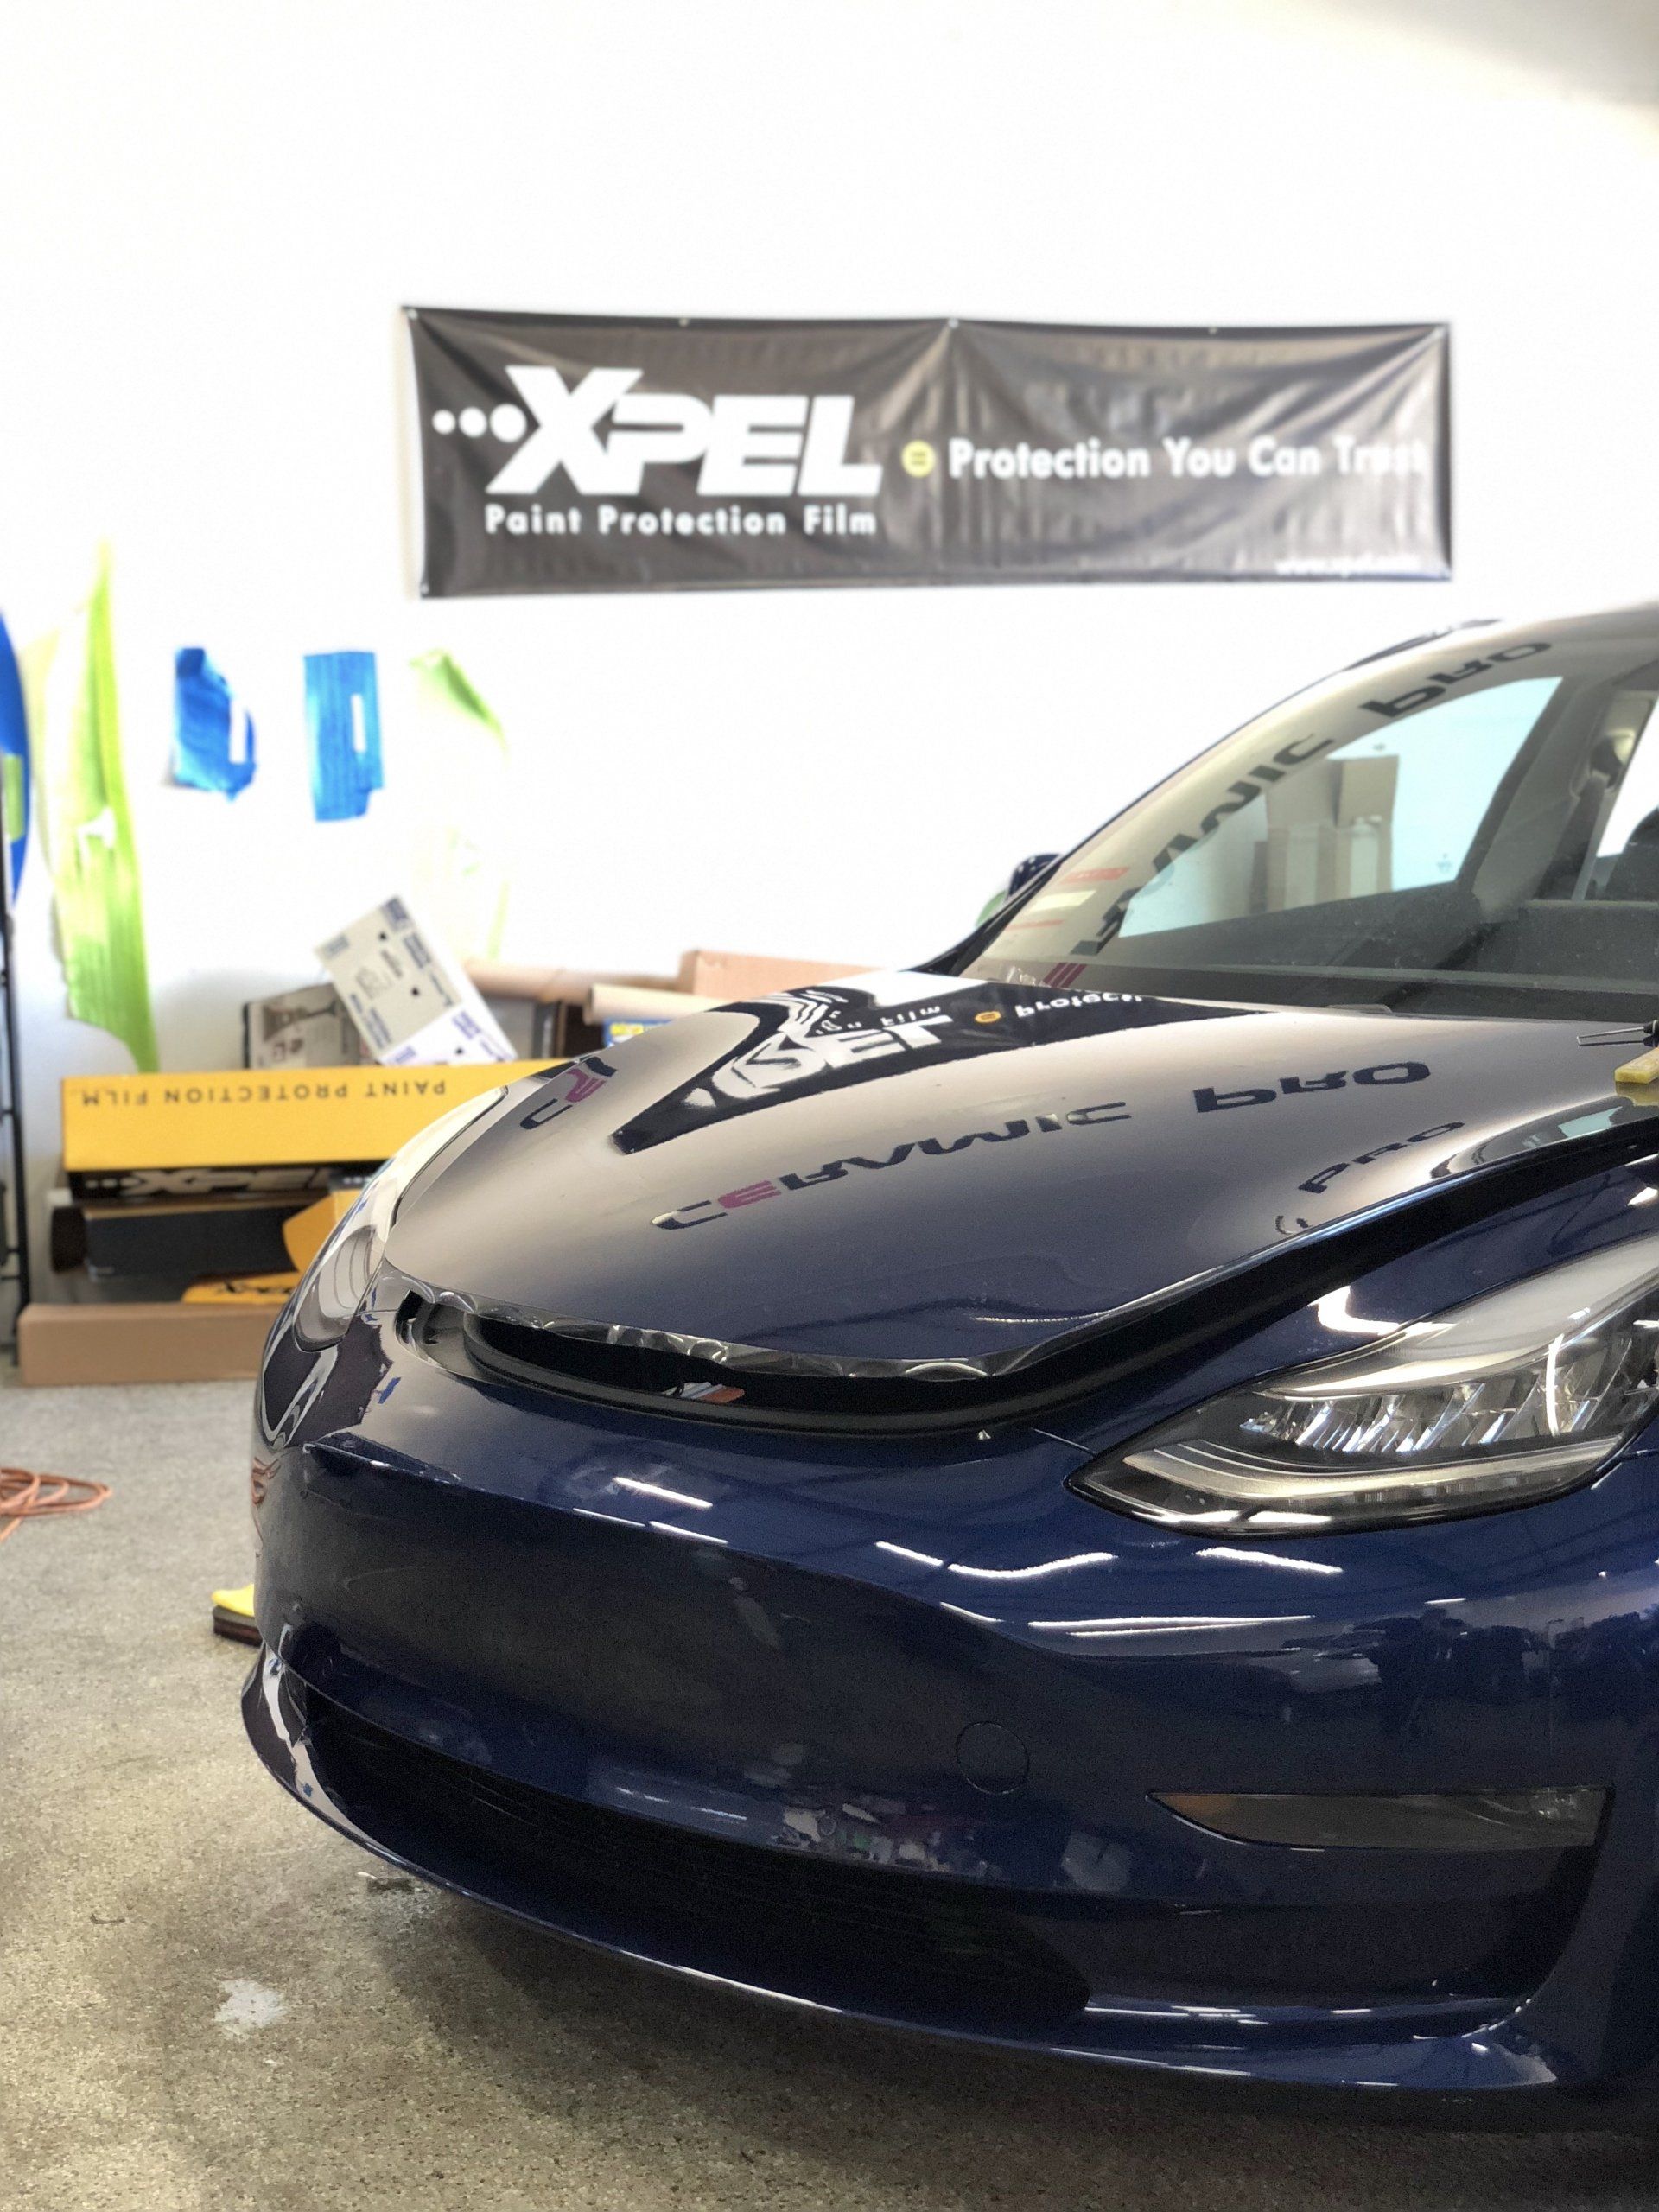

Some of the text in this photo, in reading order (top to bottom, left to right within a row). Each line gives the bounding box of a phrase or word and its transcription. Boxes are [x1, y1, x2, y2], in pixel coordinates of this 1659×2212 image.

[486, 365, 884, 497] XPEL
[949, 438, 1151, 479] Protection
[1161, 436, 1236, 479] You
[1247, 435, 1322, 477] Can
[485, 504, 877, 536] Paint Protection Film
[82, 1080, 447, 1107] PAINT PROTECTION FILM
